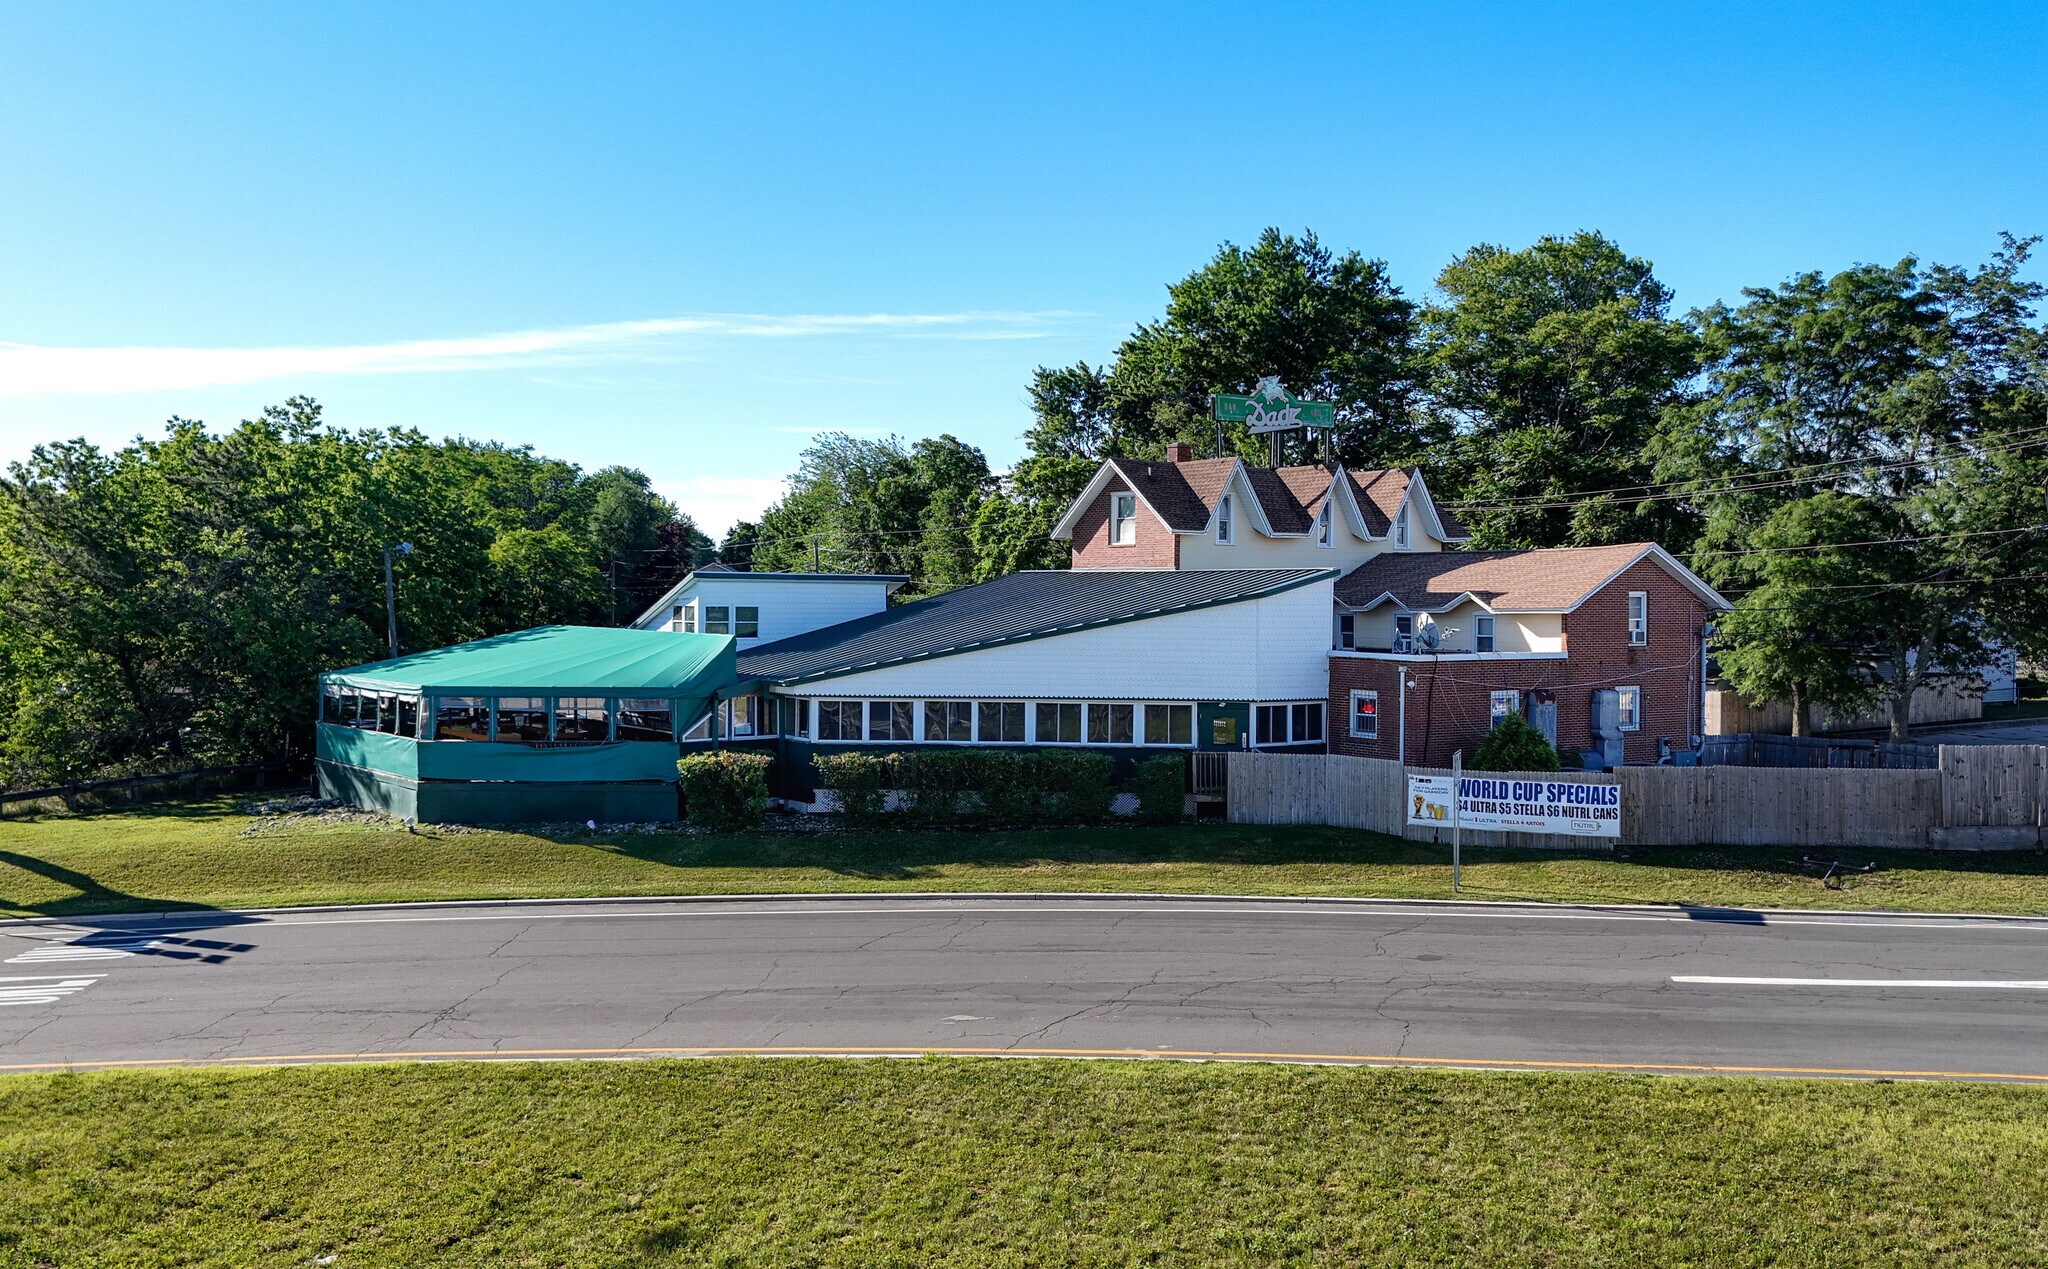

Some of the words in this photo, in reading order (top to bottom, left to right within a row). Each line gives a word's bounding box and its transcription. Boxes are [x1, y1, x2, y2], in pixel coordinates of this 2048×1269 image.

[1459, 778, 1509, 800] WORLD
[1512, 781, 1543, 802] CUP
[1546, 783, 1618, 806] SPECIALS
[1470, 800, 1497, 814] ULTRA
[1499, 801, 1512, 815] $5
[1513, 803, 1545, 817] STELLA
[1547, 804, 1560, 818] $6
[1562, 805, 1591, 819] NUTRL
[1593, 807, 1619, 820] CANS
[3, 934, 180, 963] ONLY
